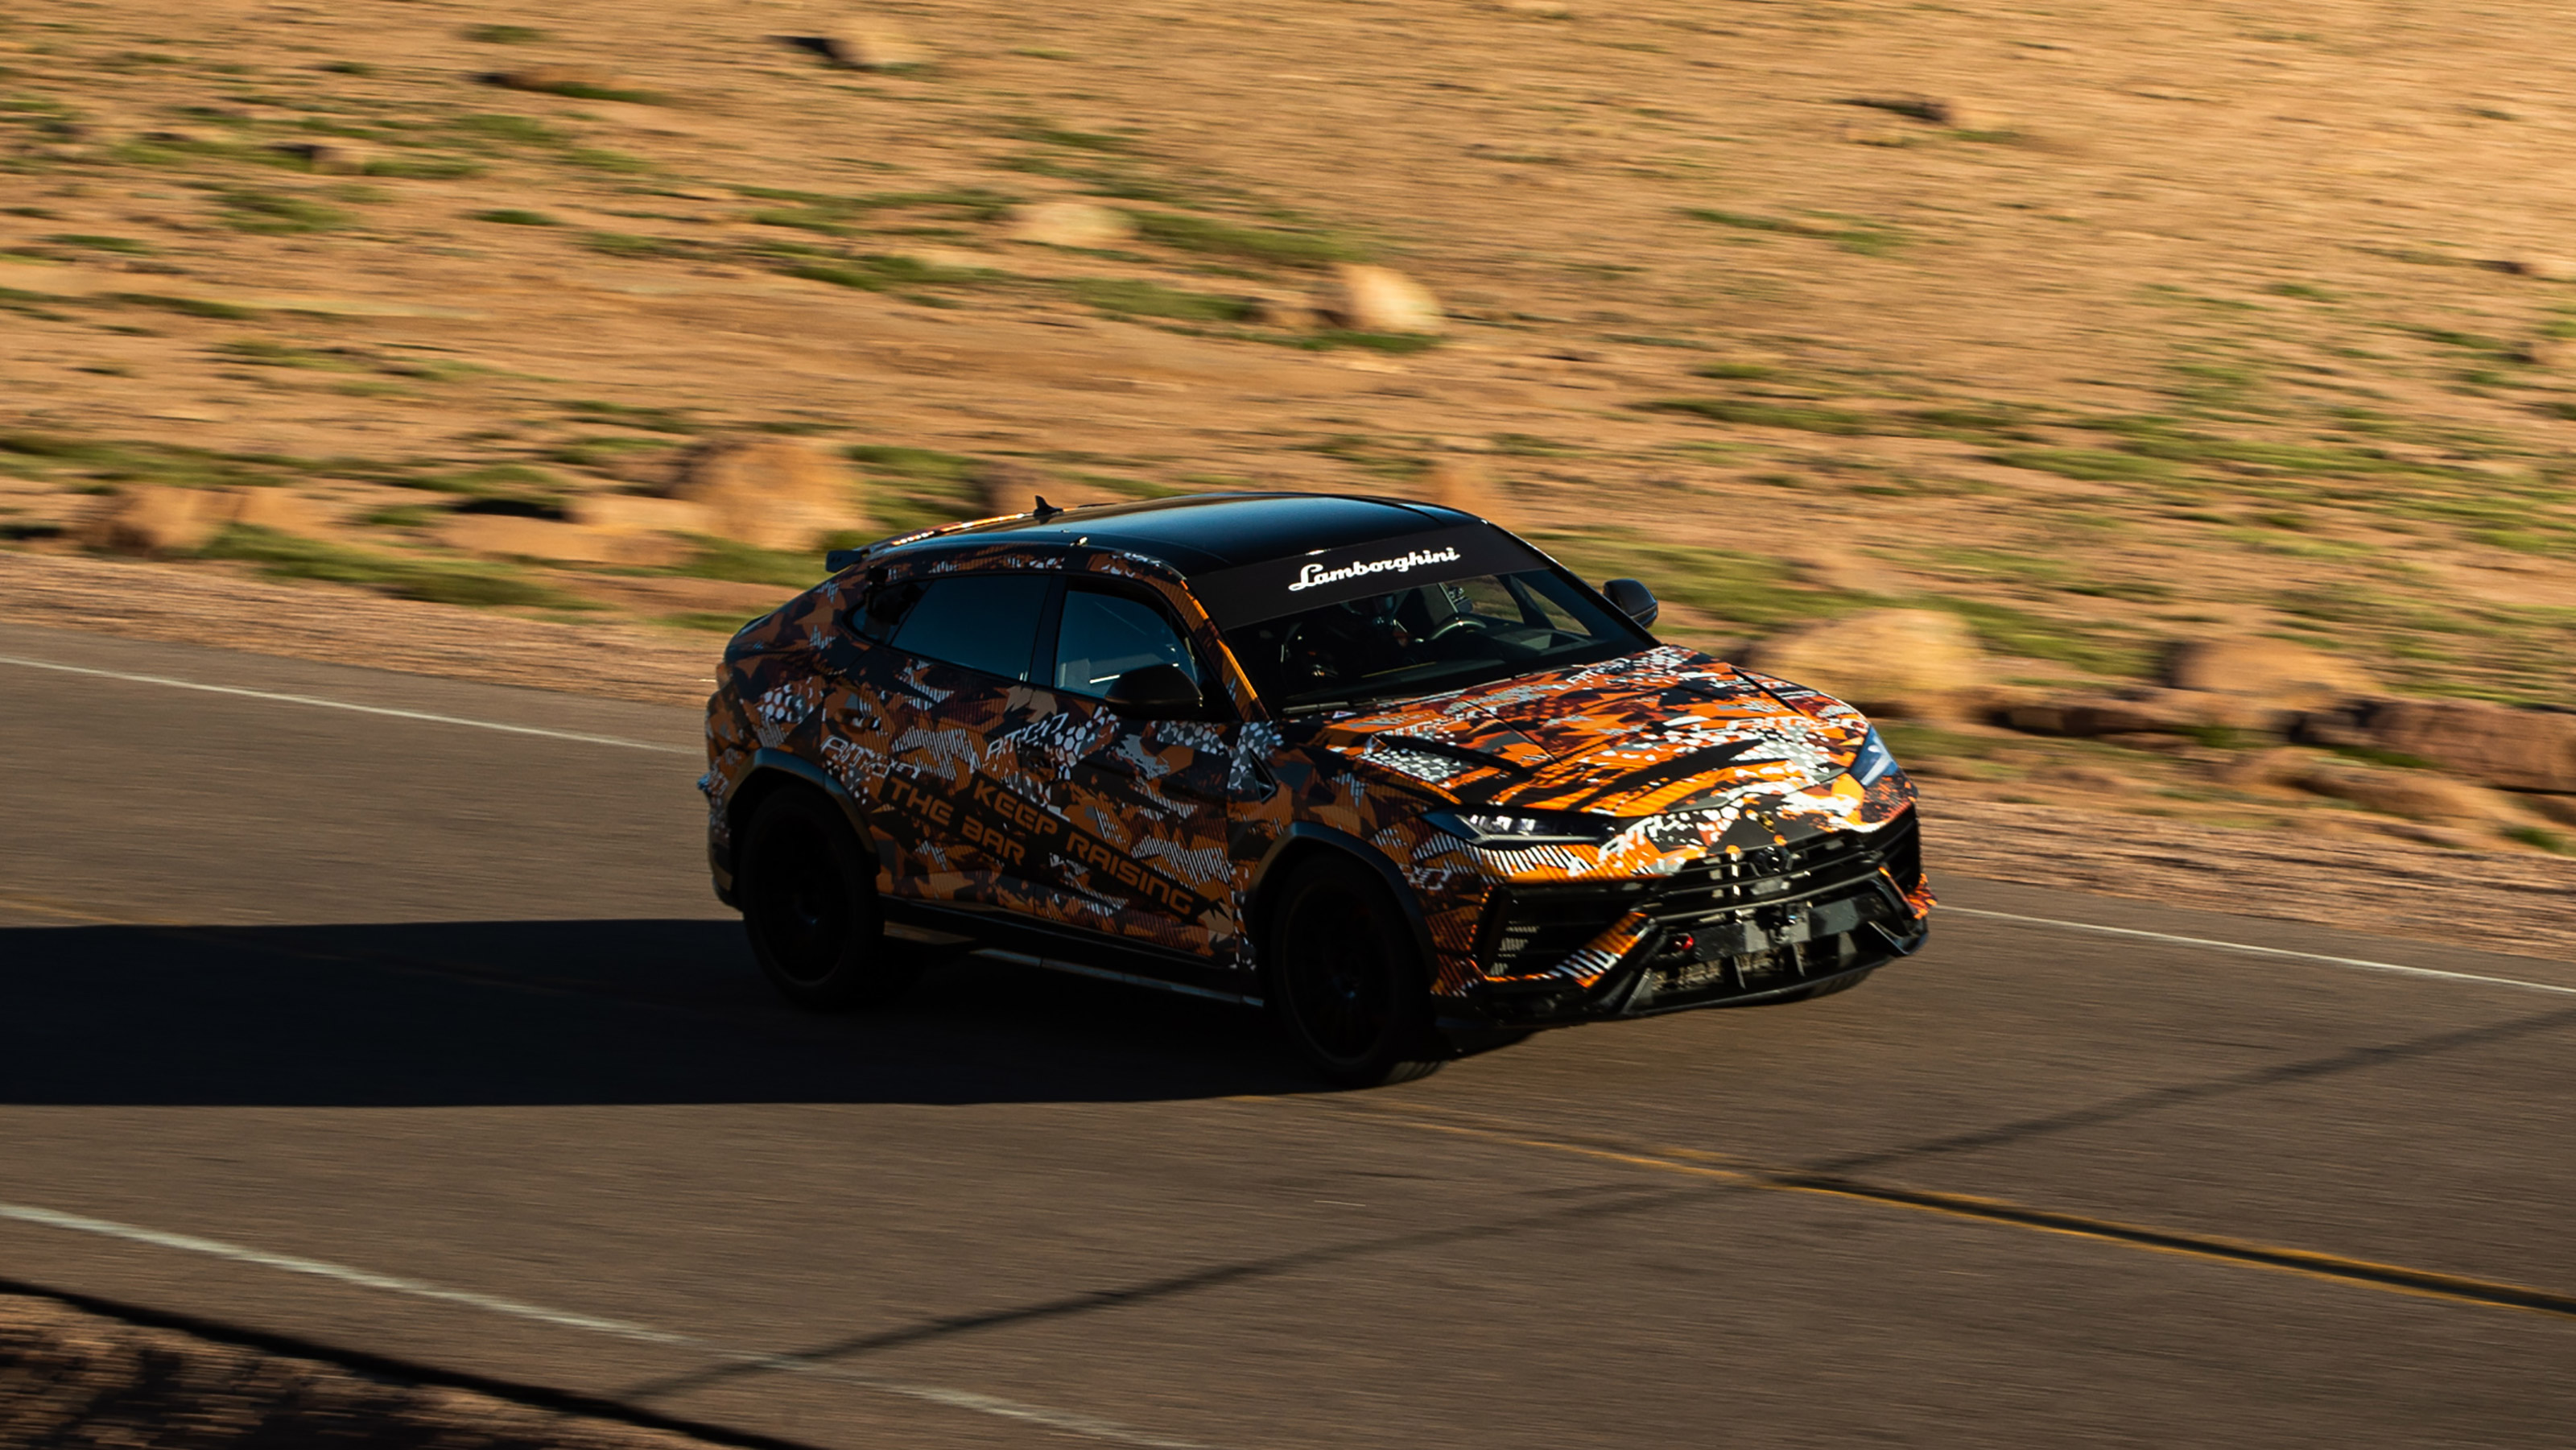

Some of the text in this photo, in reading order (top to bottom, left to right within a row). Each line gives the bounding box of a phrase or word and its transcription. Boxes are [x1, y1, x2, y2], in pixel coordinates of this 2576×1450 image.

[1288, 546, 1461, 592] Lamborghini
[889, 775, 1026, 866] THE BAR
[972, 779, 1195, 915] KEEP RAISING
